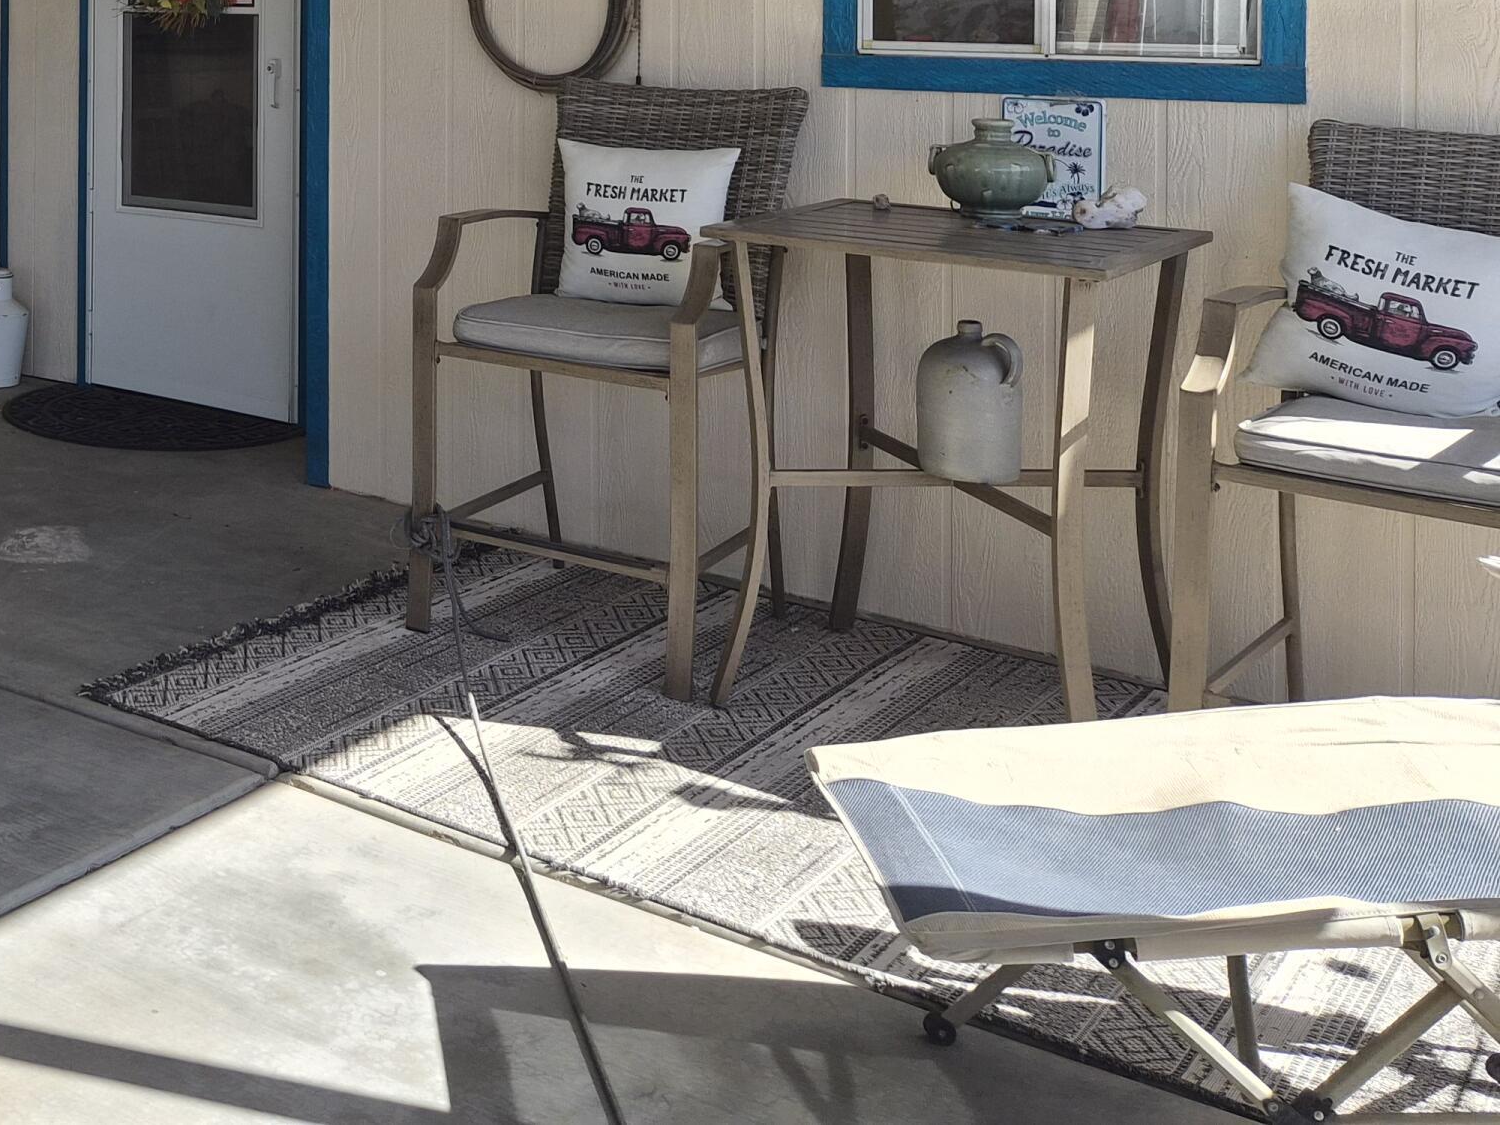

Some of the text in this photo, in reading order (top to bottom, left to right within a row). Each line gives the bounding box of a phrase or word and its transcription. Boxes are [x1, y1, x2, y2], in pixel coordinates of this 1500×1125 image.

[1017, 111, 1087, 132] Welcome
[1048, 127, 1060, 137] to
[630, 175, 644, 183] THE
[586, 182, 687, 203] FRESH MARKET
[1395, 251, 1418, 266] THE
[590, 267, 670, 281] AMERICAN MADE
[1324, 245, 1480, 299] FRESH MARKET
[631, 283, 646, 291] LOVE
[1308, 351, 1432, 393] AMERICAN MADE
[1338, 377, 1386, 398] WITH LOVE
